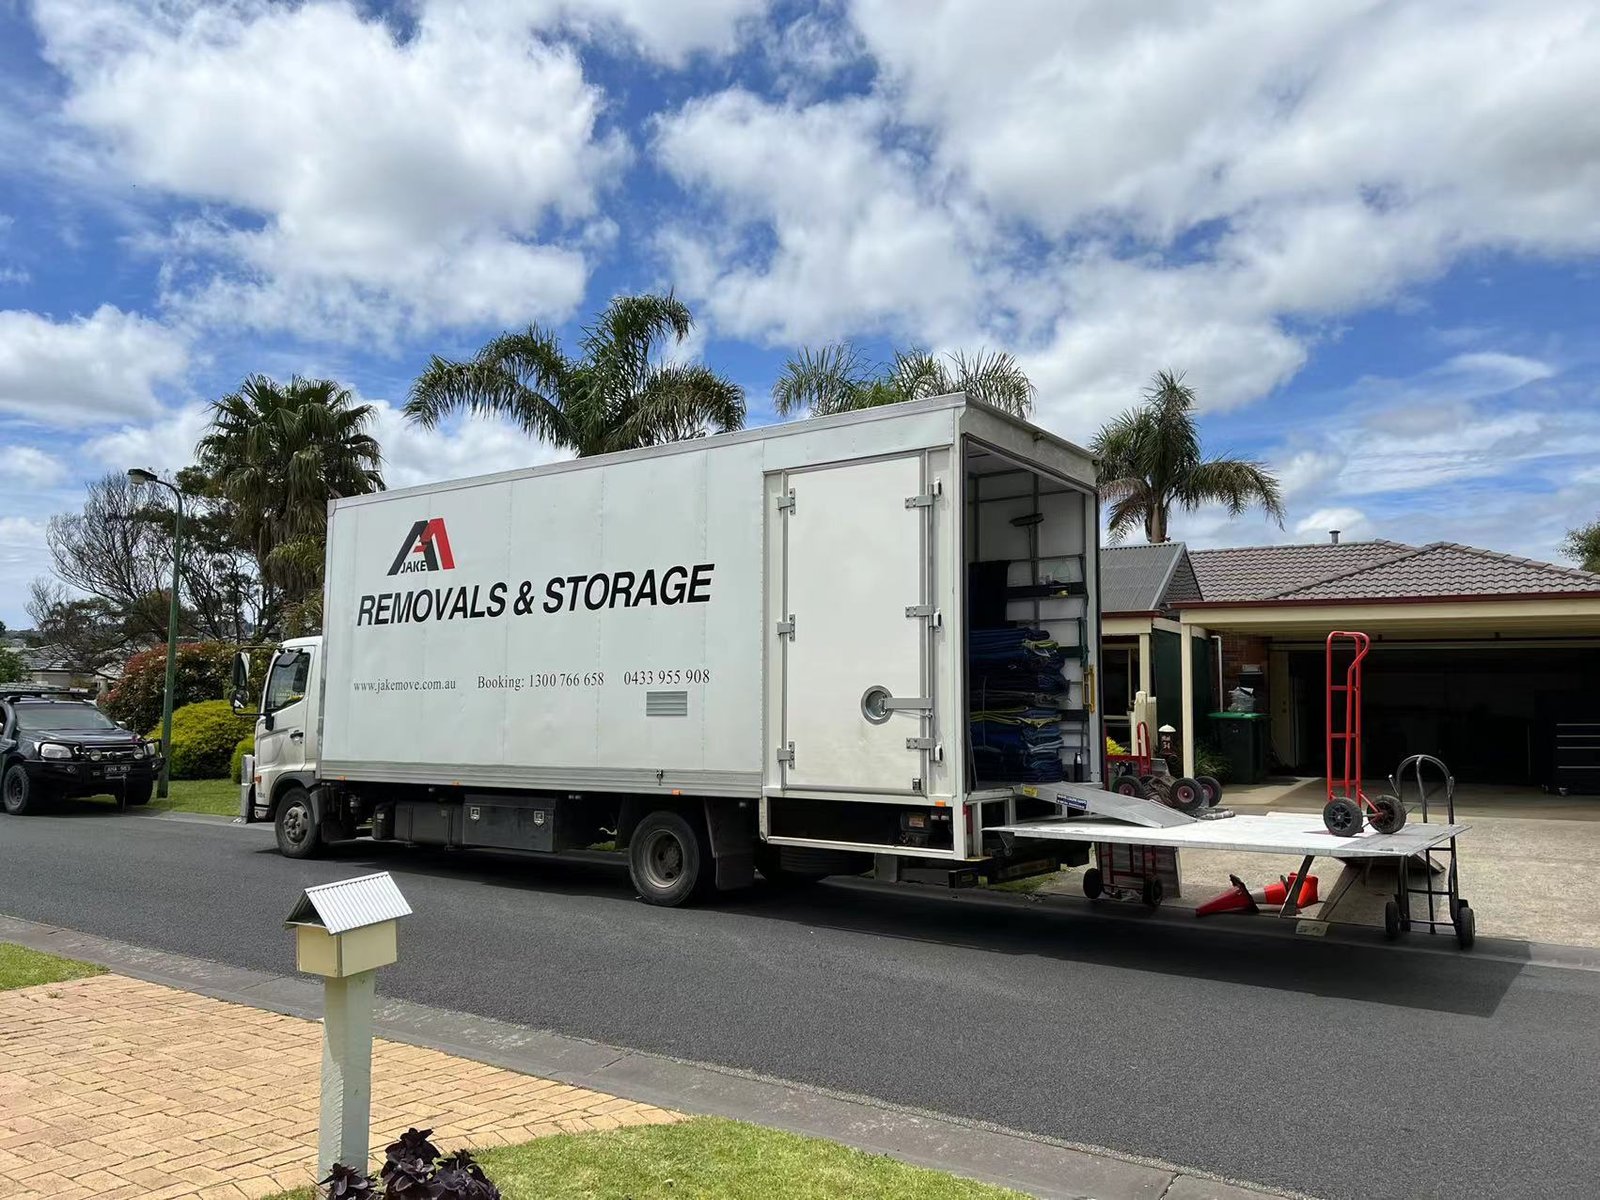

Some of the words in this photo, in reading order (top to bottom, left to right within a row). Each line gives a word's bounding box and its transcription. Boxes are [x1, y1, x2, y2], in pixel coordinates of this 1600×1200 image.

[400, 560, 427, 574] JAKE
[356, 581, 508, 627] REMOVALS
[513, 579, 535, 616] &
[542, 562, 716, 614] STORAGE
[353, 678, 456, 694] www.jakemove.com.au
[477, 674, 525, 692] Booking:
[529, 673, 557, 688] 1300
[559, 672, 580, 687] 766
[583, 671, 605, 686] 658
[623, 670, 654, 685] 0433
[658, 669, 681, 685] 955
[685, 668, 710, 684] 908
